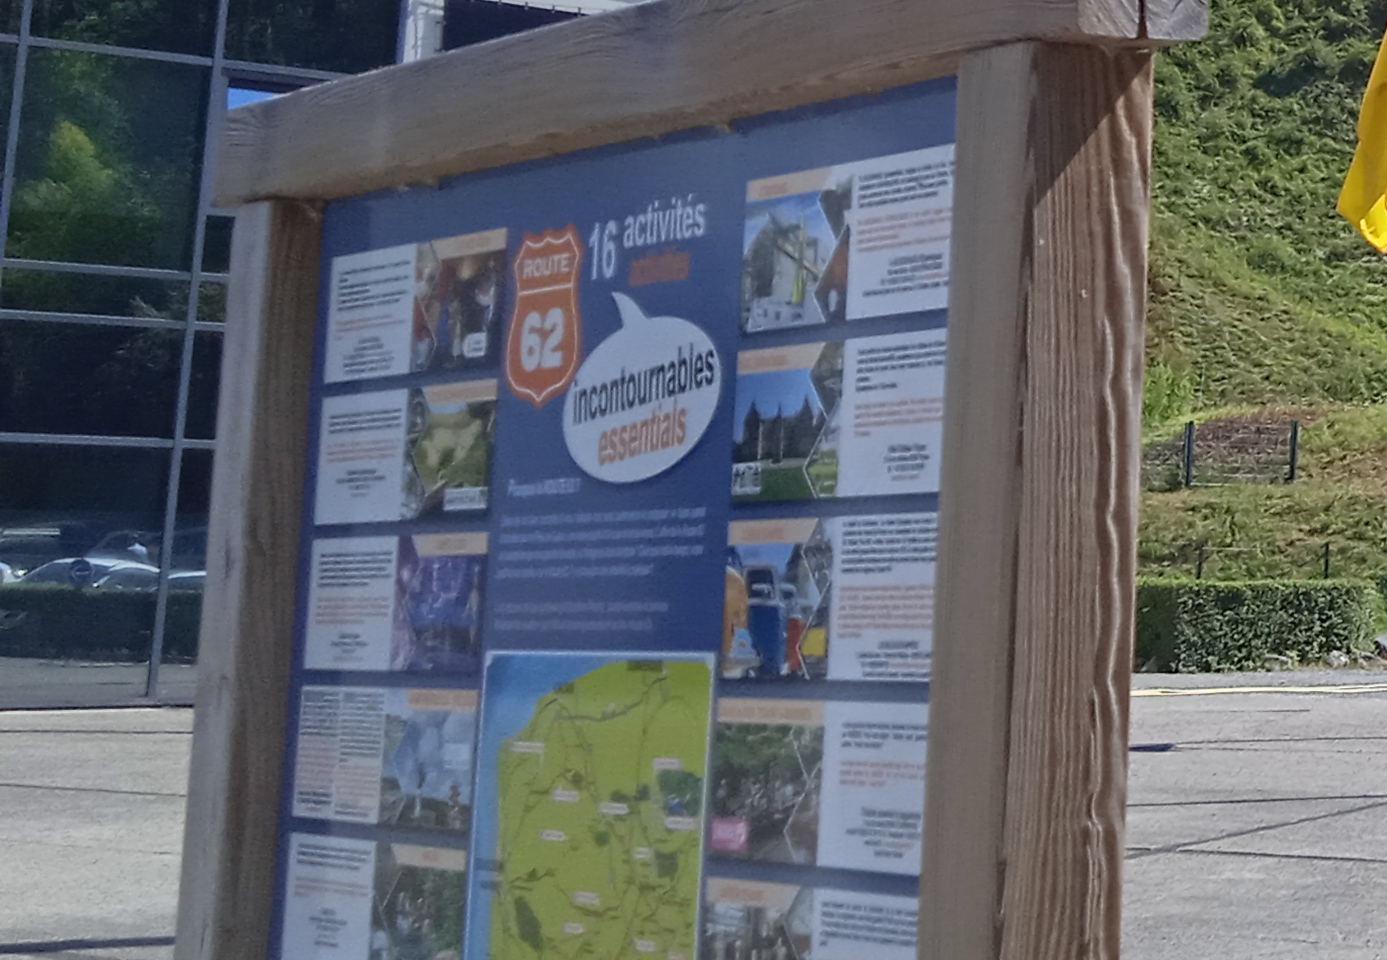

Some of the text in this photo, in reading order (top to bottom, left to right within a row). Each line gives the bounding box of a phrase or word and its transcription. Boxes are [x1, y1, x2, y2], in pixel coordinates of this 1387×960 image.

[523, 252, 571, 279] ROUTE
[588, 219, 617, 280] 16
[623, 193, 706, 249] activités
[520, 307, 565, 372] 62
[571, 343, 714, 426] incontournables
[598, 401, 687, 465] essentials
